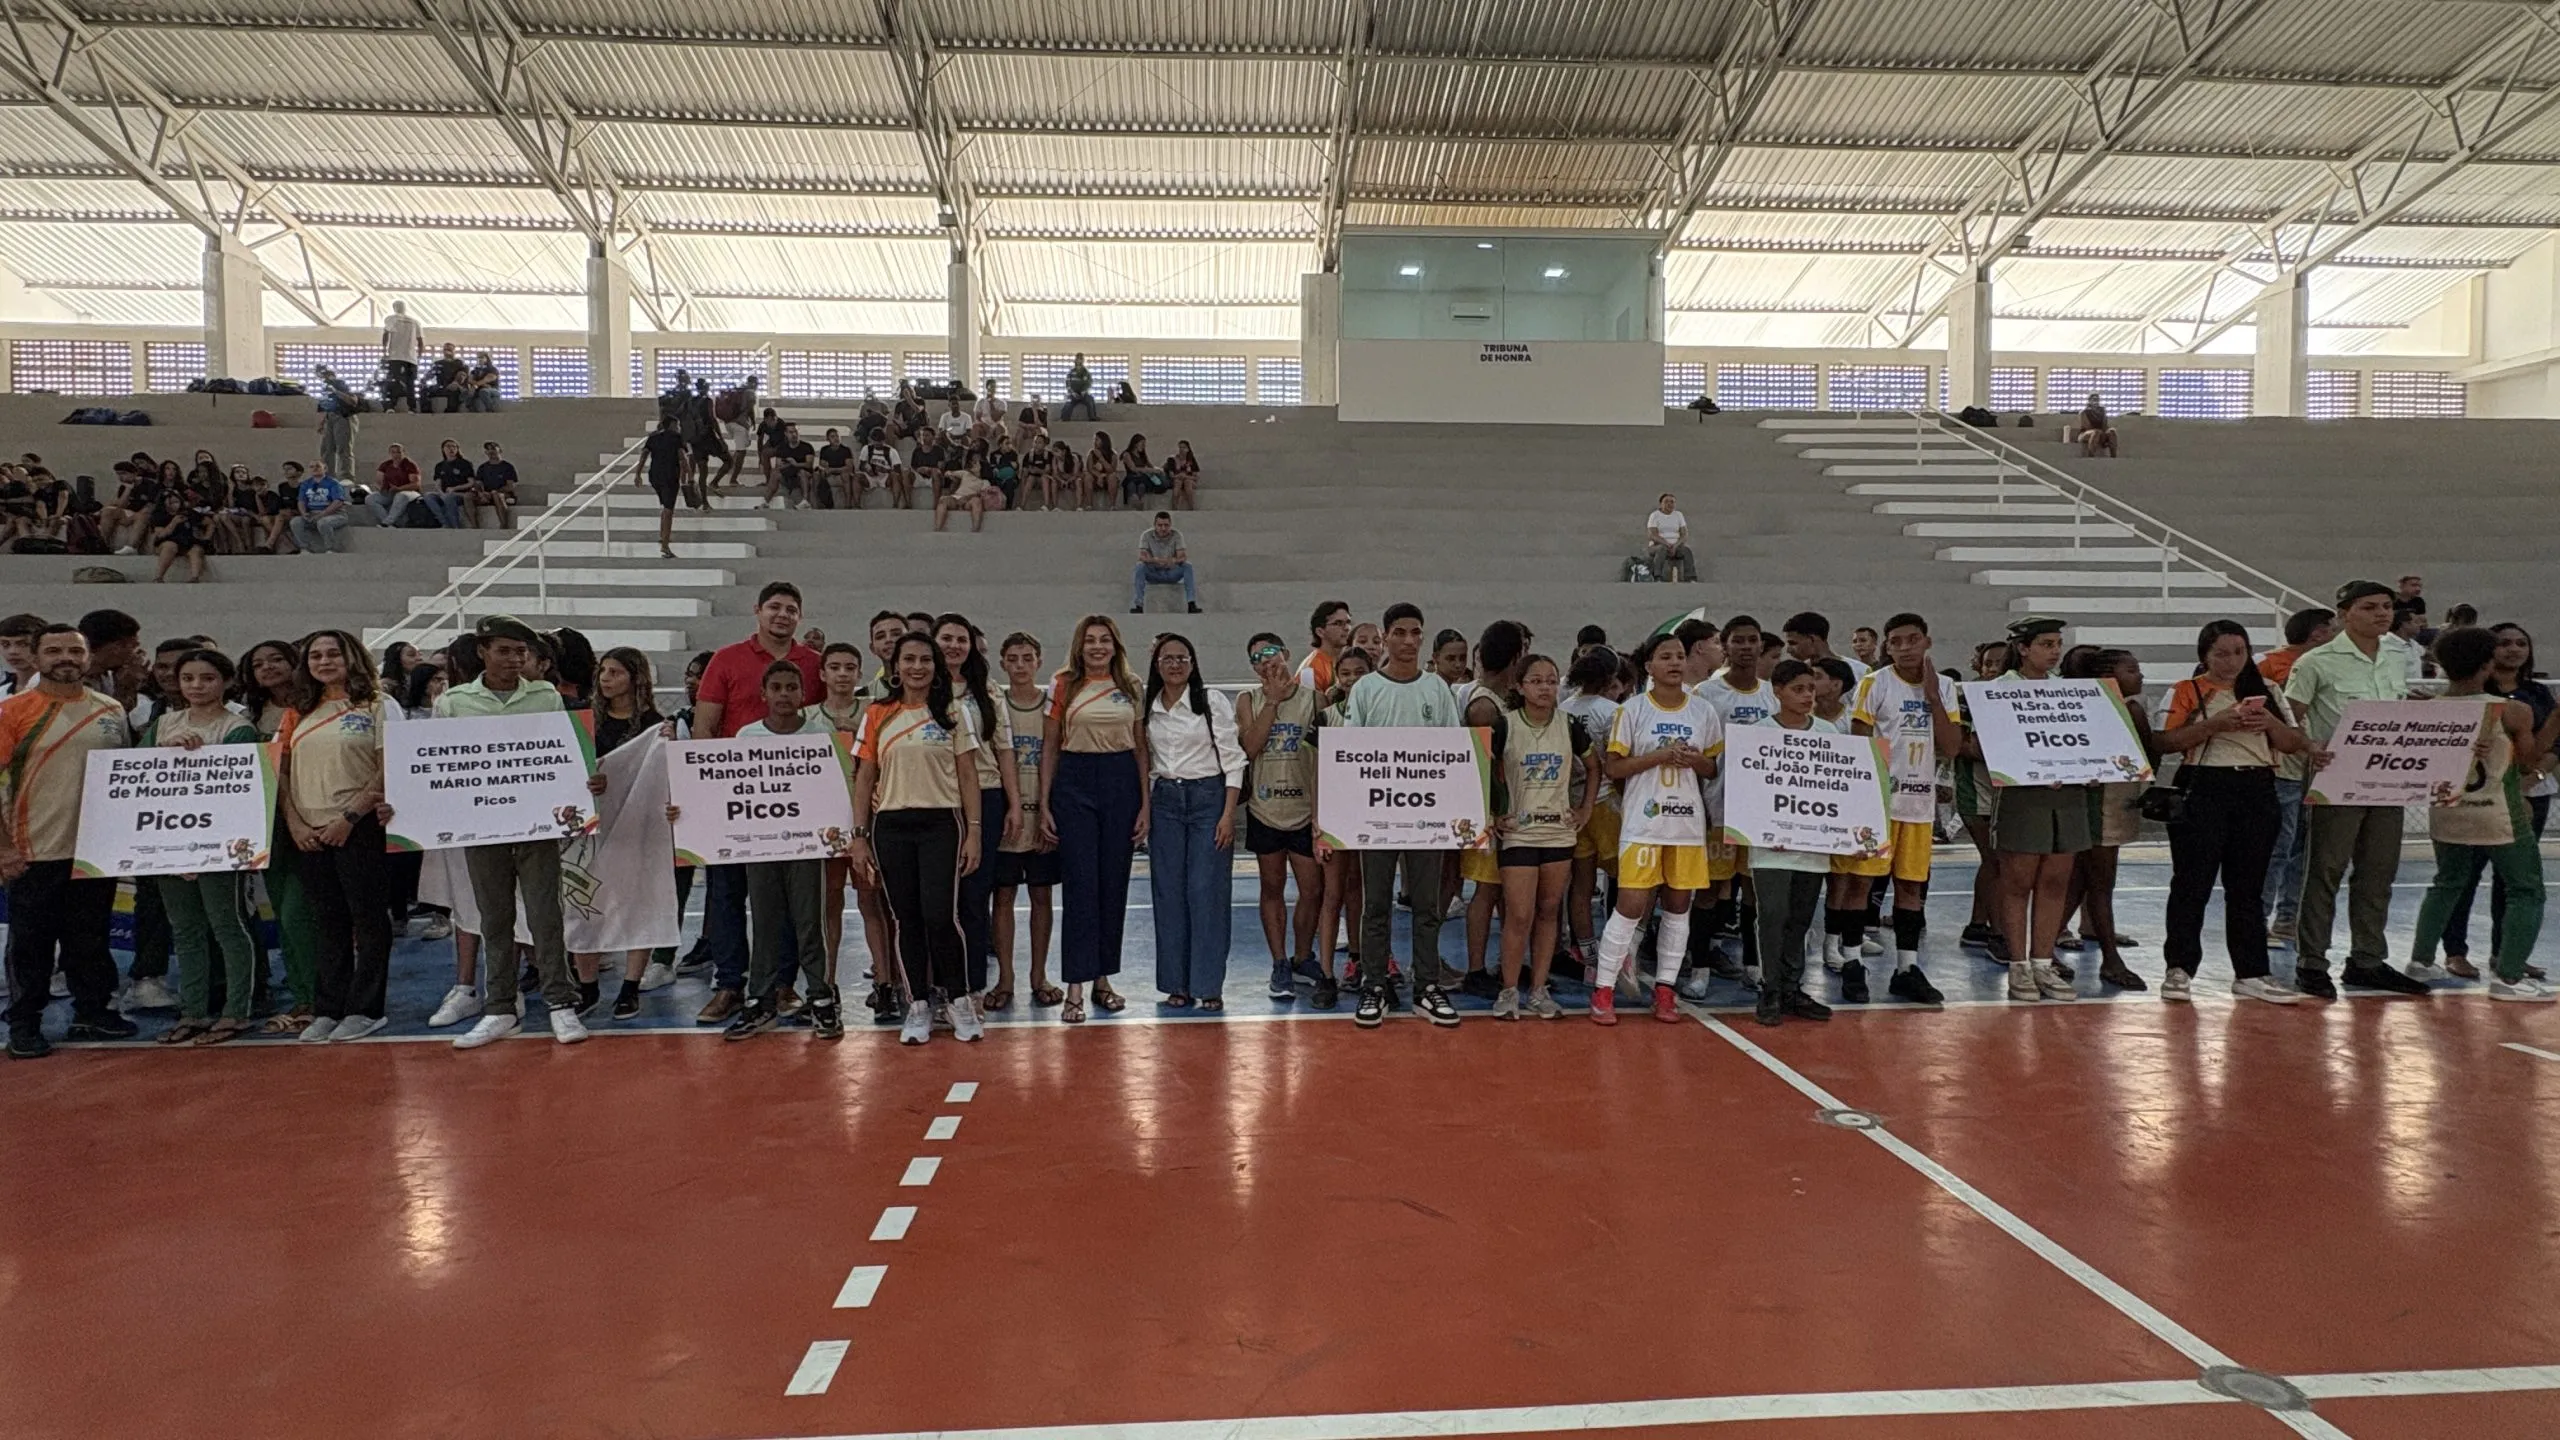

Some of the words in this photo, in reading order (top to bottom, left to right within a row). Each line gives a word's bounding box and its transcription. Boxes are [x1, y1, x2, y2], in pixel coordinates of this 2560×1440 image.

[1483, 344, 1529, 353] TRIBUNA
[1480, 354, 1493, 362] DE
[1495, 354, 1532, 362] HONRA
[1985, 688, 2031, 700] Escola
[2033, 687, 2101, 701] Municipal
[2012, 701, 2055, 712] N.Sra.
[2058, 700, 2083, 710] dos
[2017, 712, 2087, 724] Remédios
[2351, 720, 2401, 732] Escola
[2404, 721, 2477, 734] Municipal
[417, 744, 482, 757] CENTRO
[487, 738, 565, 753] ESTADUAL
[1783, 734, 1831, 749] Escola
[2025, 731, 2091, 748] Picos
[2344, 734, 2389, 746] N.Sra.
[2393, 735, 2470, 748] Aparecida
[112, 757, 168, 771] Escola
[173, 753, 254, 770] Municipal
[685, 750, 743, 764] Escola
[749, 745, 833, 762] Municipal
[1335, 750, 1388, 763] Escola
[1393, 750, 1471, 765] Municipal
[1759, 745, 1805, 761] Cívico
[1809, 750, 1856, 766] Militar
[1908, 741, 1924, 766] 11
[2365, 753, 2429, 771] Picos
[411, 764, 432, 774] DE
[436, 760, 491, 773] TEMPO
[497, 754, 573, 769] INTEGRAL
[700, 765, 763, 780] Manoel
[769, 763, 822, 776] Inácio
[1360, 766, 1391, 779] Heli
[1396, 767, 1446, 779] Nunes
[1741, 757, 1770, 771] Cel.
[1774, 761, 1810, 775] João
[1814, 764, 1872, 781] Ferreira
[109, 773, 150, 785] Prof.
[155, 769, 201, 783] Otília
[206, 769, 254, 781] Neiva
[430, 776, 482, 789] MÁRIO
[487, 772, 556, 786] MARTINS
[1765, 773, 1784, 786] de
[1787, 776, 1850, 792] Almeida
[109, 786, 131, 799] de
[135, 784, 188, 798] Moura
[193, 782, 251, 795] Santos
[733, 782, 755, 795] da
[760, 781, 792, 794] Luz
[1274, 788, 1304, 797] PICOS
[1901, 783, 1931, 793] PICOS
[474, 796, 517, 806] Picos
[1369, 788, 1436, 808] Picos
[1774, 794, 1839, 818] Picos
[727, 800, 800, 820] Picos
[1662, 805, 1694, 815] PICOS
[136, 810, 213, 831] Picos
[1636, 847, 1656, 868] 01
